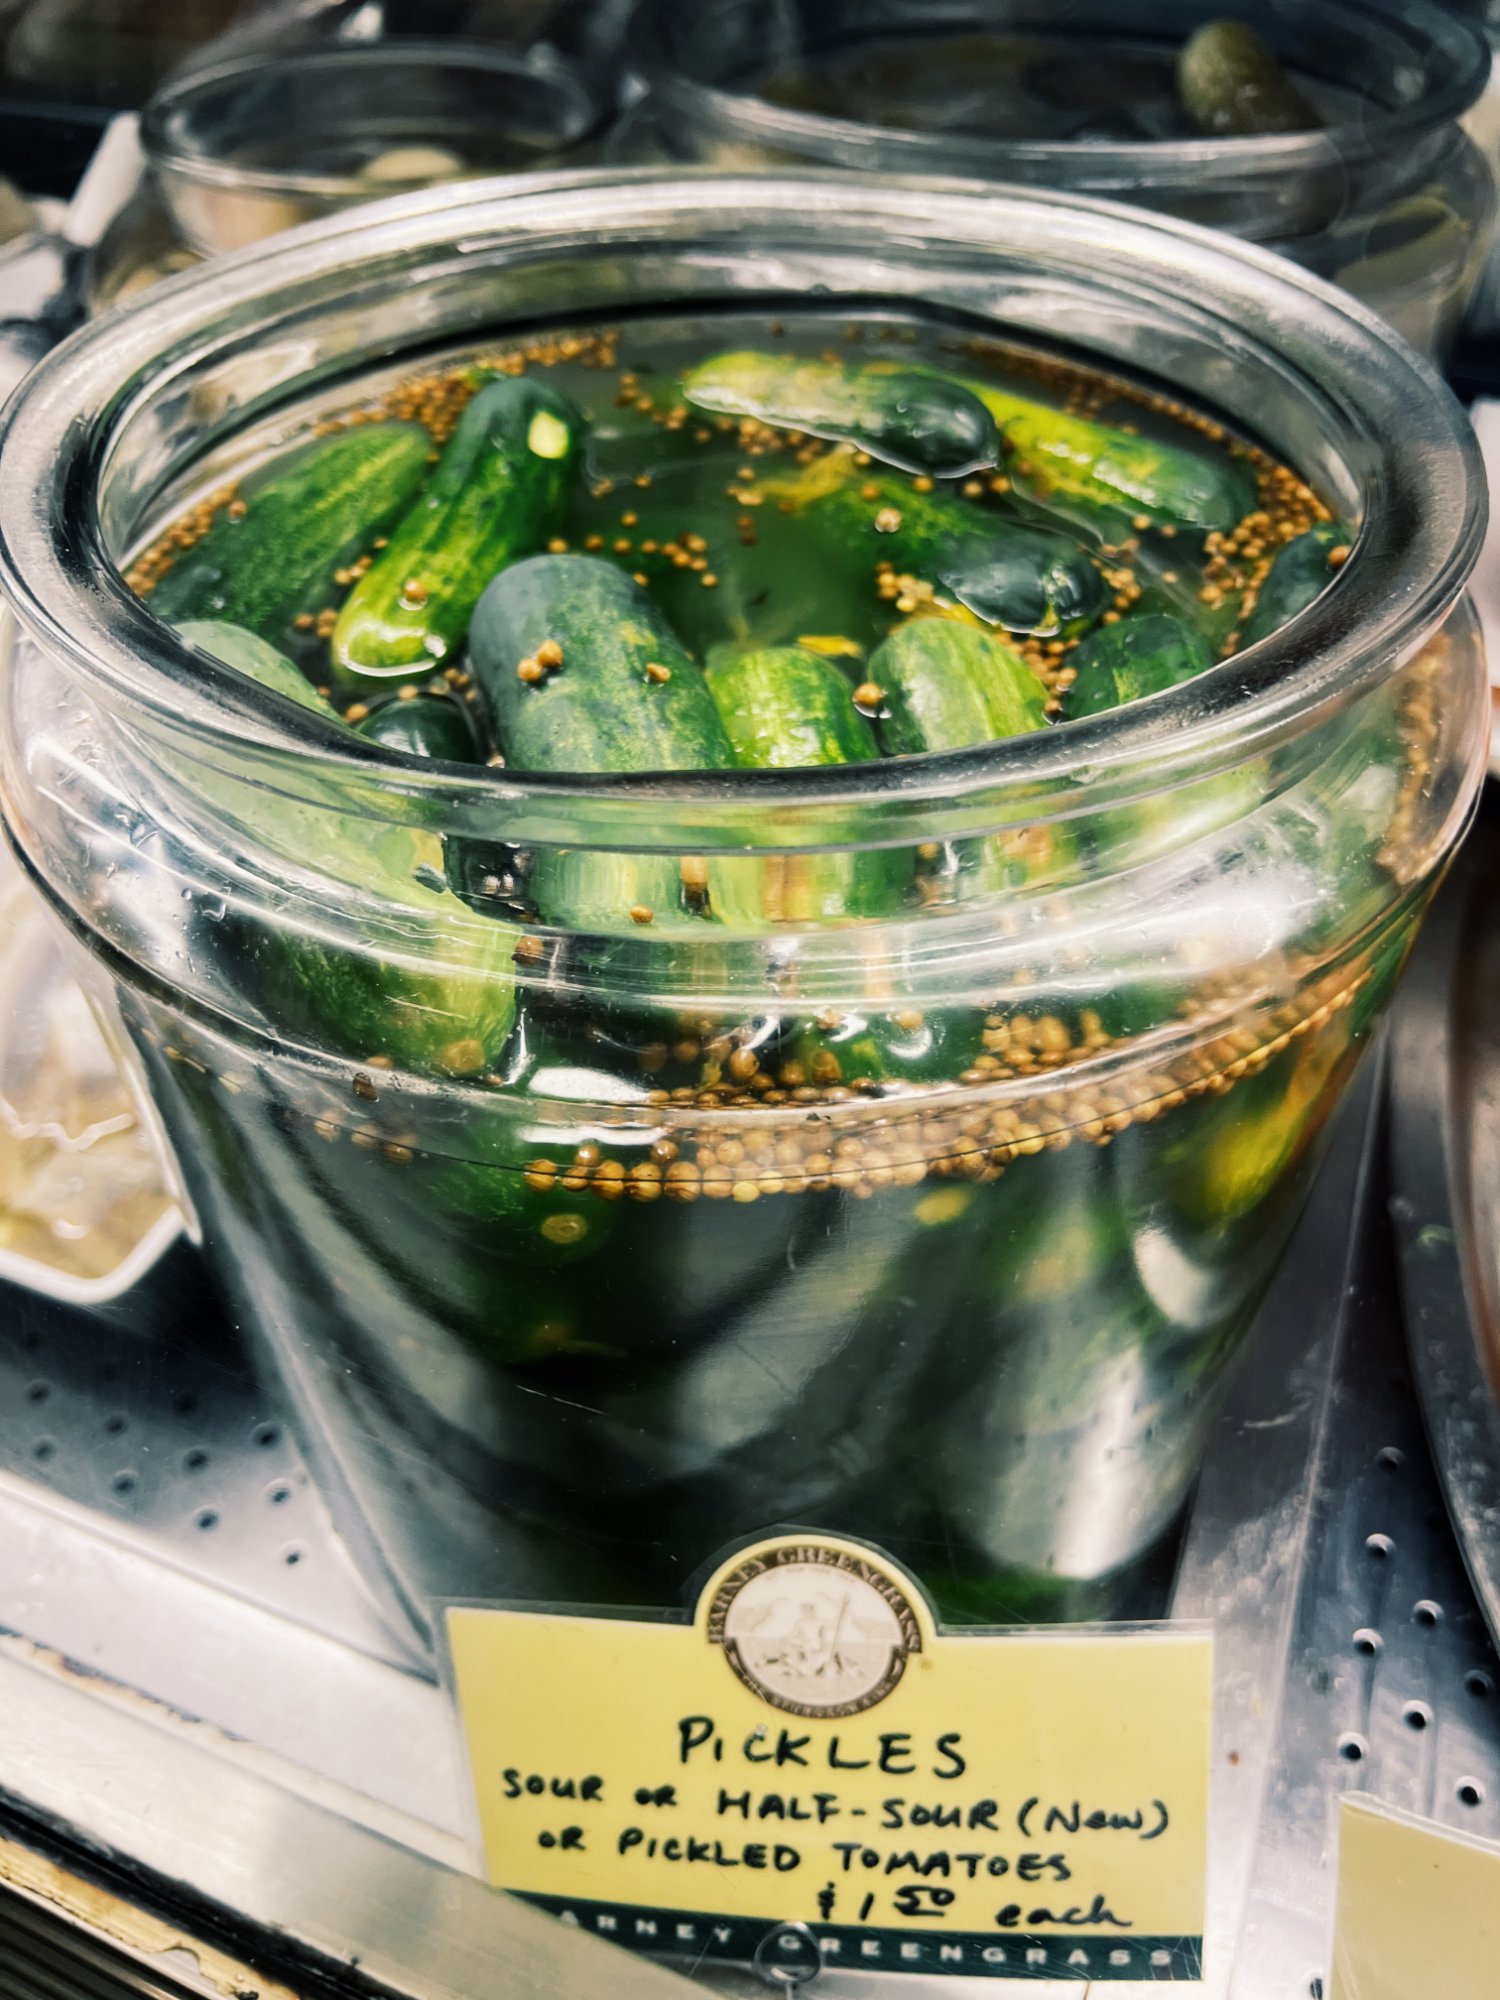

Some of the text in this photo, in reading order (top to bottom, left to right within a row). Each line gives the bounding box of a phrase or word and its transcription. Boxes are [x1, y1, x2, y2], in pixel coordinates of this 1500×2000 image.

[707, 1546, 921, 1651] BARNEY GREENGRASS
[678, 1715, 967, 1780] PICKLES
[502, 1767, 603, 1802] SOUR
[716, 1788, 999, 1832] HALF-SOUR
[617, 1826, 801, 1873] PICKLED
[832, 1842, 1072, 1882] TOMATOES
[560, 1910, 1173, 1967] ARNEY GREENGRASS
[995, 1893, 1133, 1927] each
